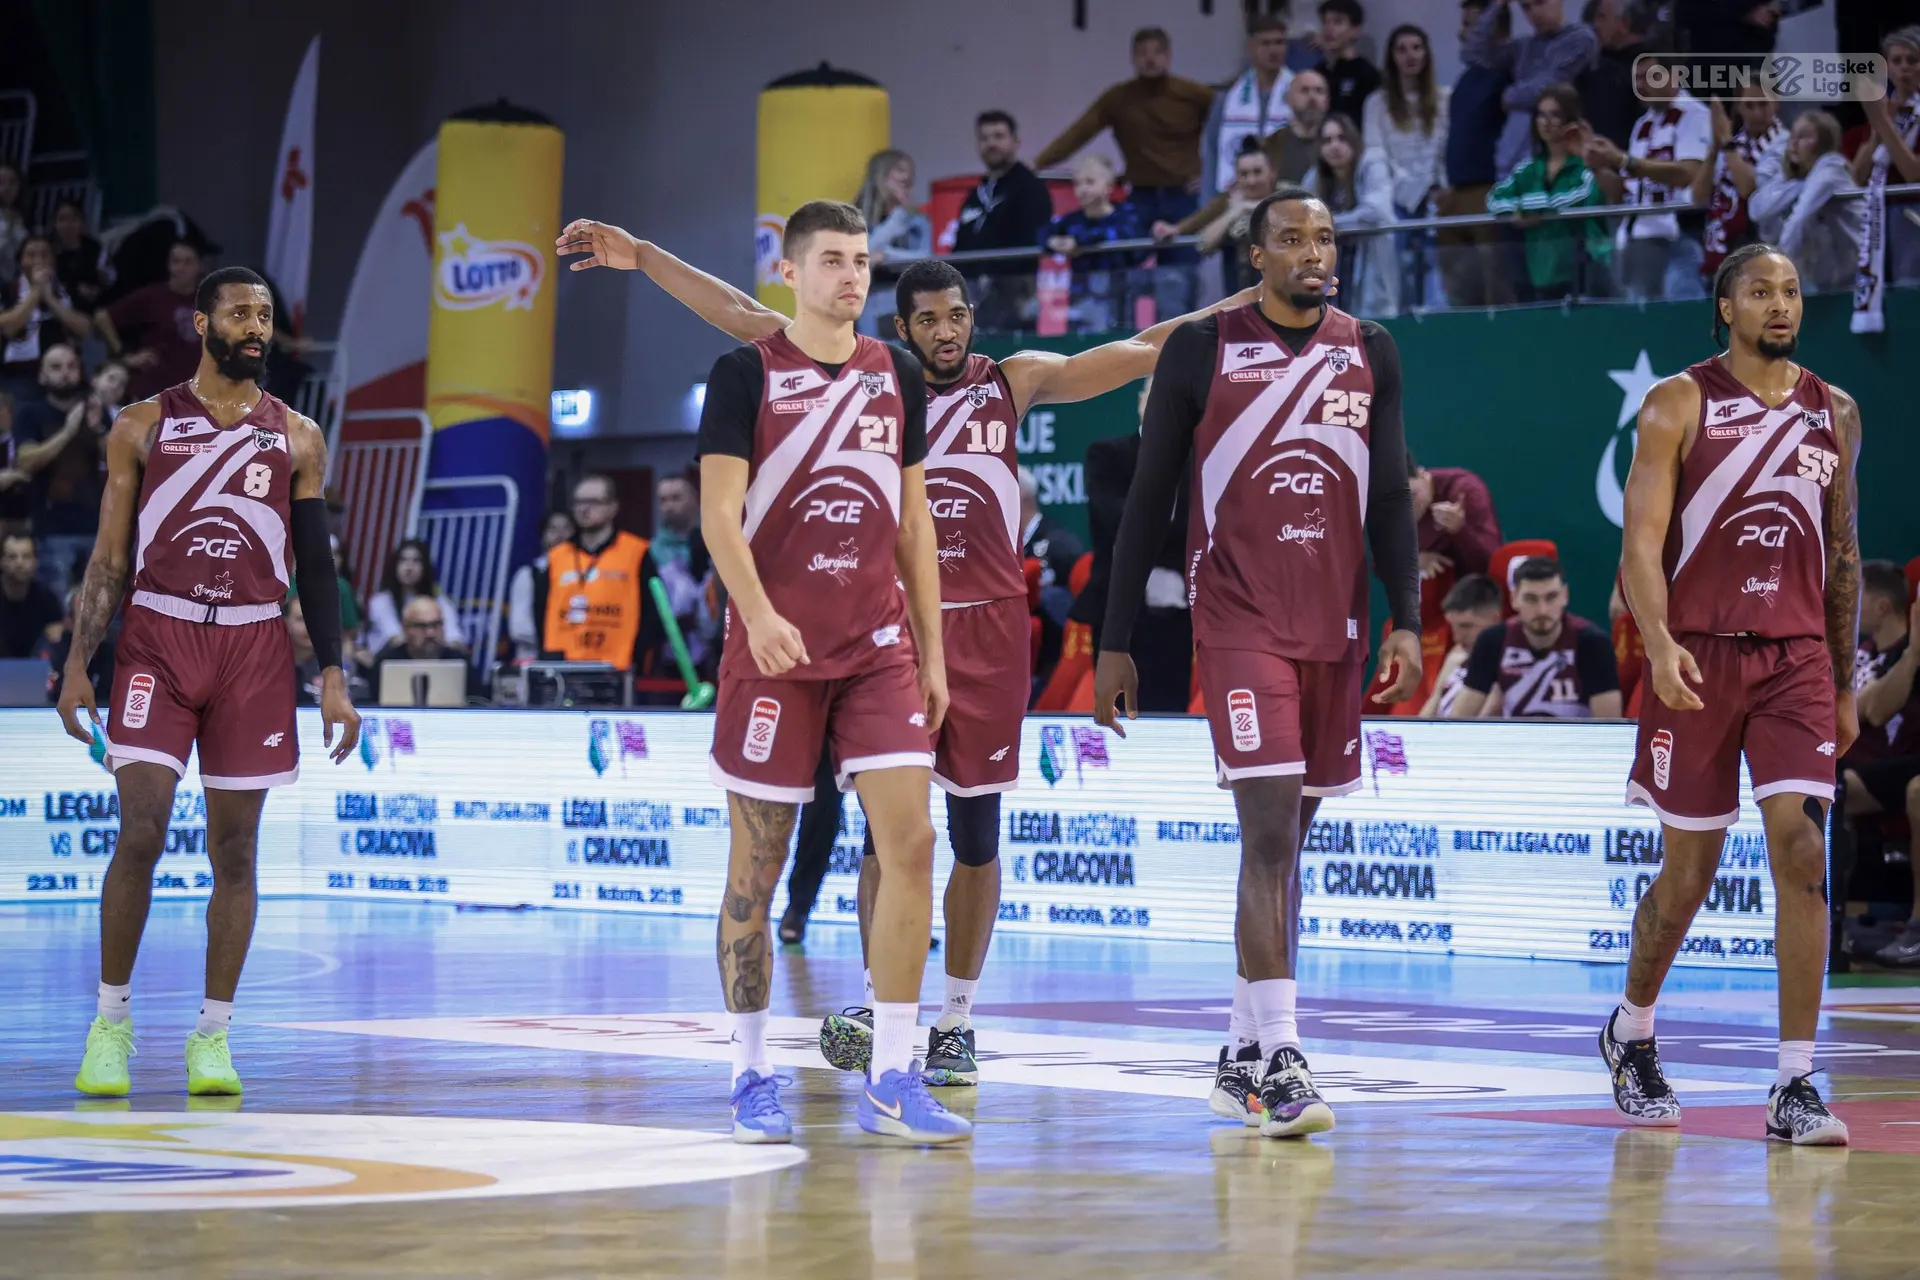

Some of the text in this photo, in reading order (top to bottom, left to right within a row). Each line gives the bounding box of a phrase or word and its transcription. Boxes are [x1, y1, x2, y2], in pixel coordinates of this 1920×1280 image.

[452, 260, 522, 293] LOTTO
[1237, 347, 1263, 359] 4F
[780, 376, 804, 390] 4F
[1231, 371, 1259, 380] ORLEN
[775, 402, 803, 411] ORLEN
[1321, 390, 1371, 428] 25
[1714, 403, 1739, 418] 4F
[172, 421, 196, 434] 4F
[858, 416, 898, 454] 21
[966, 420, 1007, 453] 10
[1710, 427, 1738, 437] ORLEN
[164, 443, 189, 452] ORLEN
[1797, 444, 1839, 487] 55
[244, 463, 272, 498] 8
[1269, 473, 1324, 494] PGE
[804, 500, 864, 523] PGE
[1277, 524, 1325, 544] Stargard
[186, 538, 241, 559] PGE
[808, 554, 859, 574] Stargard
[190, 583, 232, 602] Stargard
[1551, 678, 1579, 700] 11
[755, 706, 777, 716] ORLEN
[909, 712, 925, 727] 4F
[263, 732, 284, 747] 4F
[747, 742, 768, 751] Basket
[1815, 741, 1836, 756] 4F
[750, 749, 764, 757] Liga
[988, 745, 1010, 761] 4F
[1009, 811, 1062, 844] LEGIA
[49, 832, 71, 856] VS
[1453, 830, 1591, 854] BILETY.LEGIA.COM
[1034, 851, 1134, 886] CRACOVIA
[1324, 862, 1435, 899] CRACOVIA
